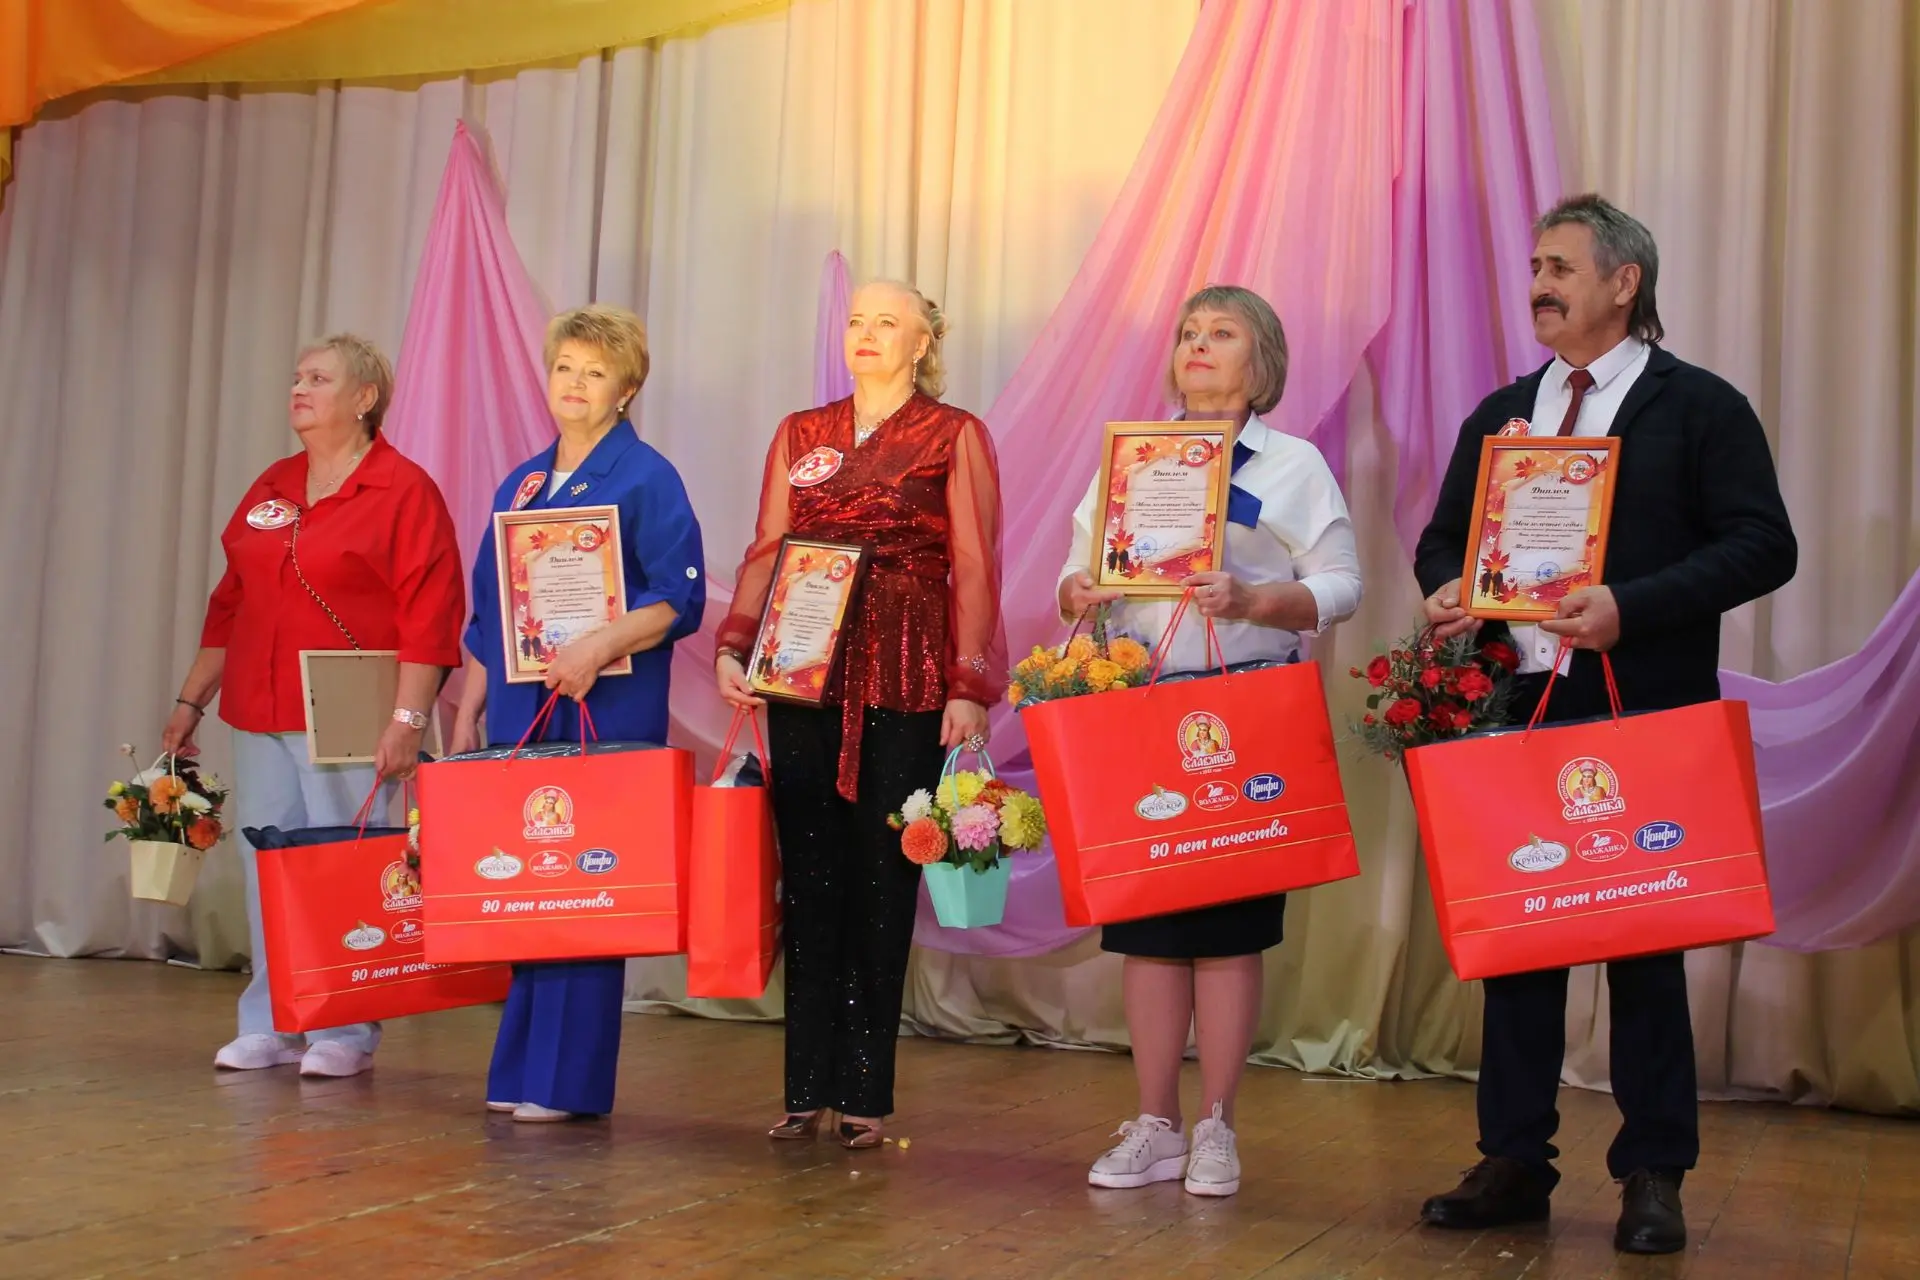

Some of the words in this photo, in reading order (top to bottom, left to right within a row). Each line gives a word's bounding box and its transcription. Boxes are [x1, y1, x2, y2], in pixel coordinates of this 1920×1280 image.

[1531, 486, 1571, 495] Диплом
[1249, 776, 1280, 800] Конфи
[1564, 799, 1623, 818] СЛАВЯНКА
[1150, 842, 1170, 859] 90
[1174, 837, 1207, 855] лет
[1211, 819, 1288, 849] качества
[1642, 824, 1678, 850] Конфи
[1581, 842, 1626, 857] ВОЛЖАНКА
[482, 900, 500, 913] 90
[504, 901, 535, 913] лет
[538, 891, 615, 911] качества
[1524, 895, 1547, 914] 90
[1552, 890, 1591, 910] лет
[1595, 870, 1689, 902] качества
[351, 968, 368, 982] 90
[371, 966, 399, 979] лет
